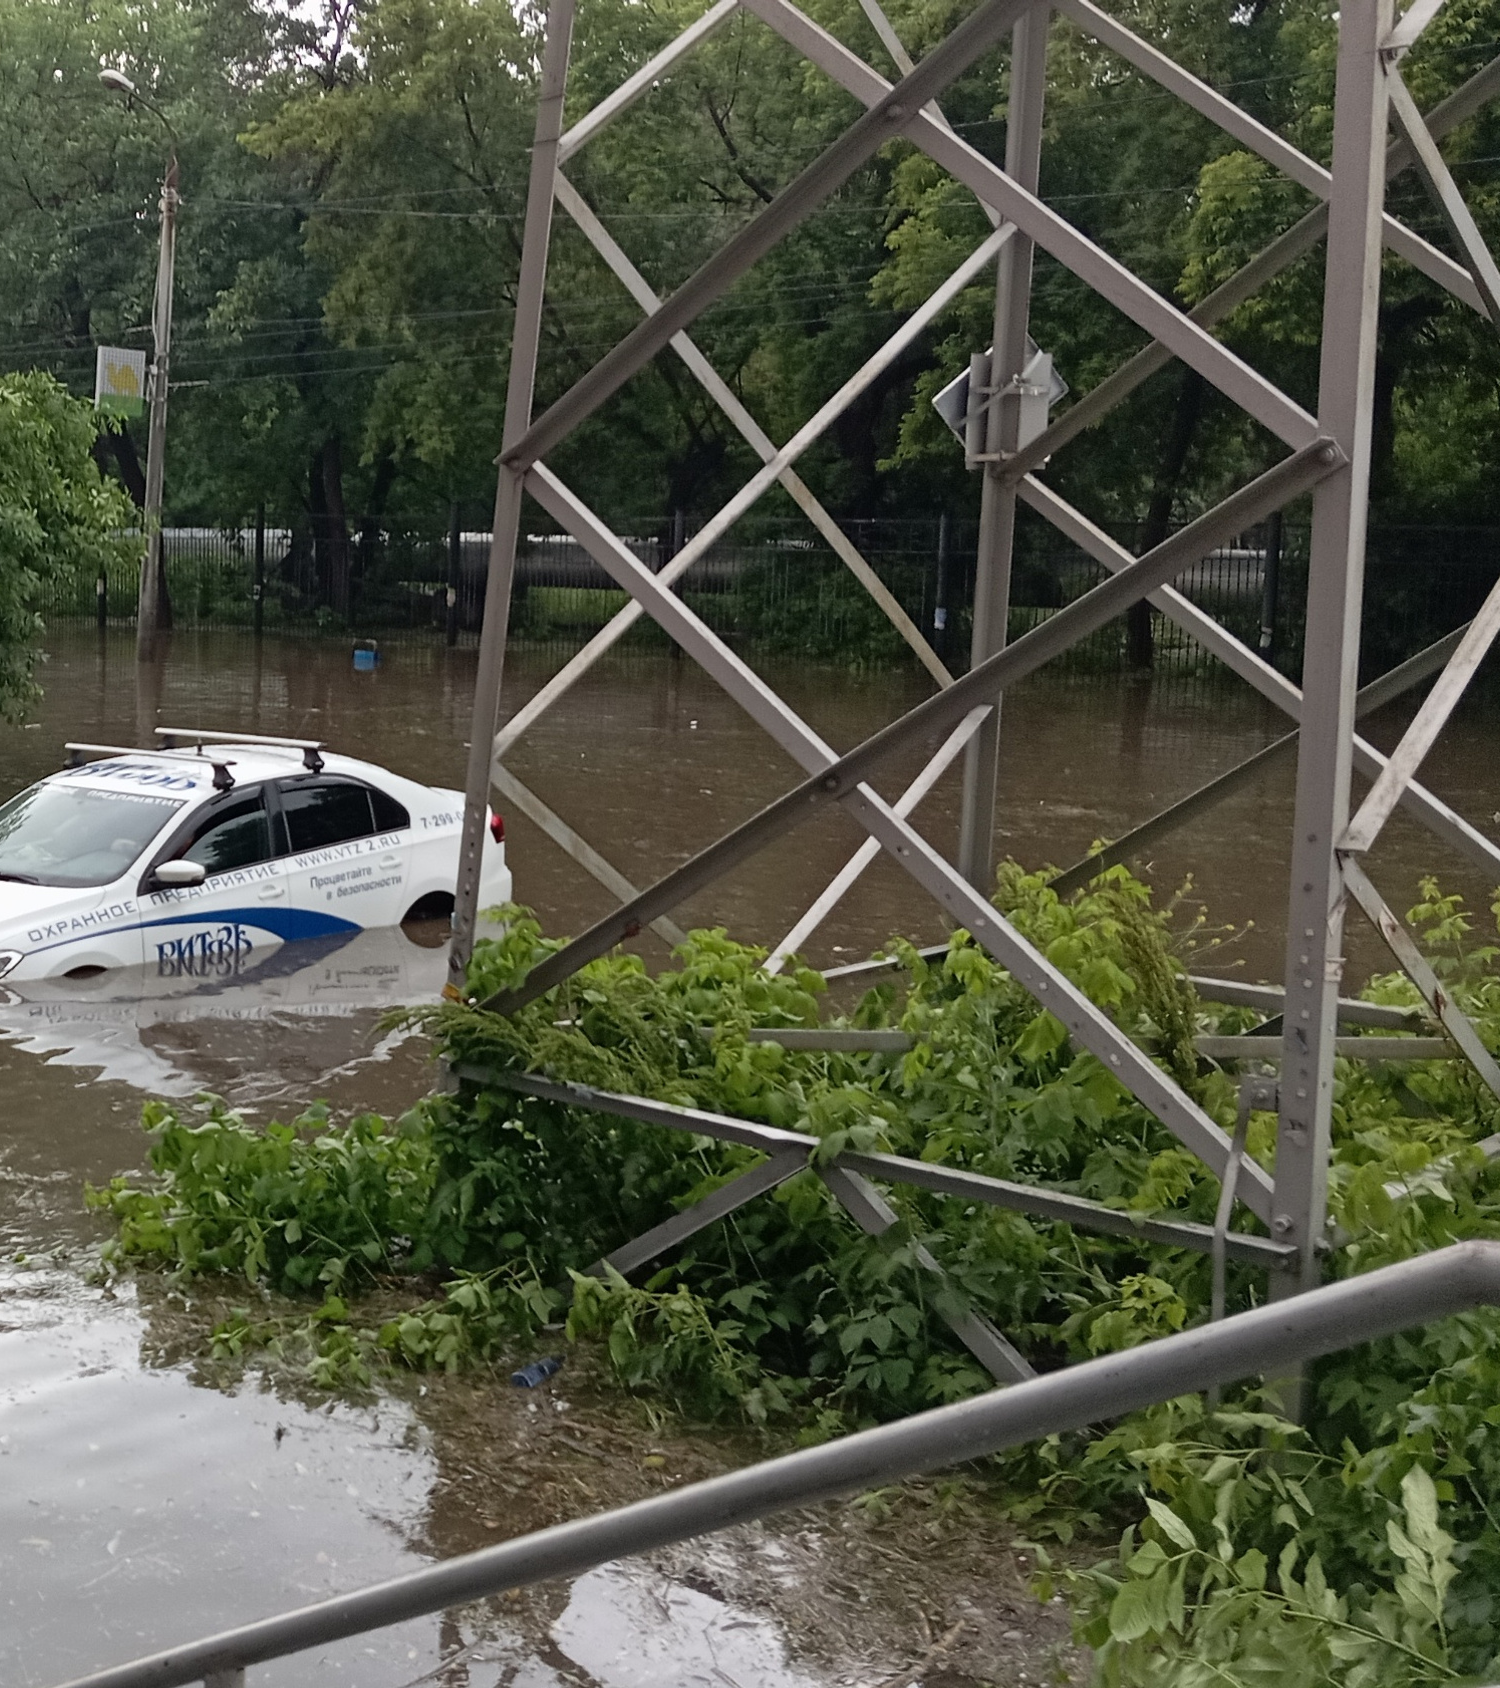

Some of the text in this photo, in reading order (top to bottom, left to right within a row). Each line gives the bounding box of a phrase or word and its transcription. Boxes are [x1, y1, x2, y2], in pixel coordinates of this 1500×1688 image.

[310, 866, 372, 890] Процветайте
[337, 876, 402, 898] безопасности
[27, 863, 280, 943] ОХРАННОЕ ПРЕДПРИЯТИЕ
